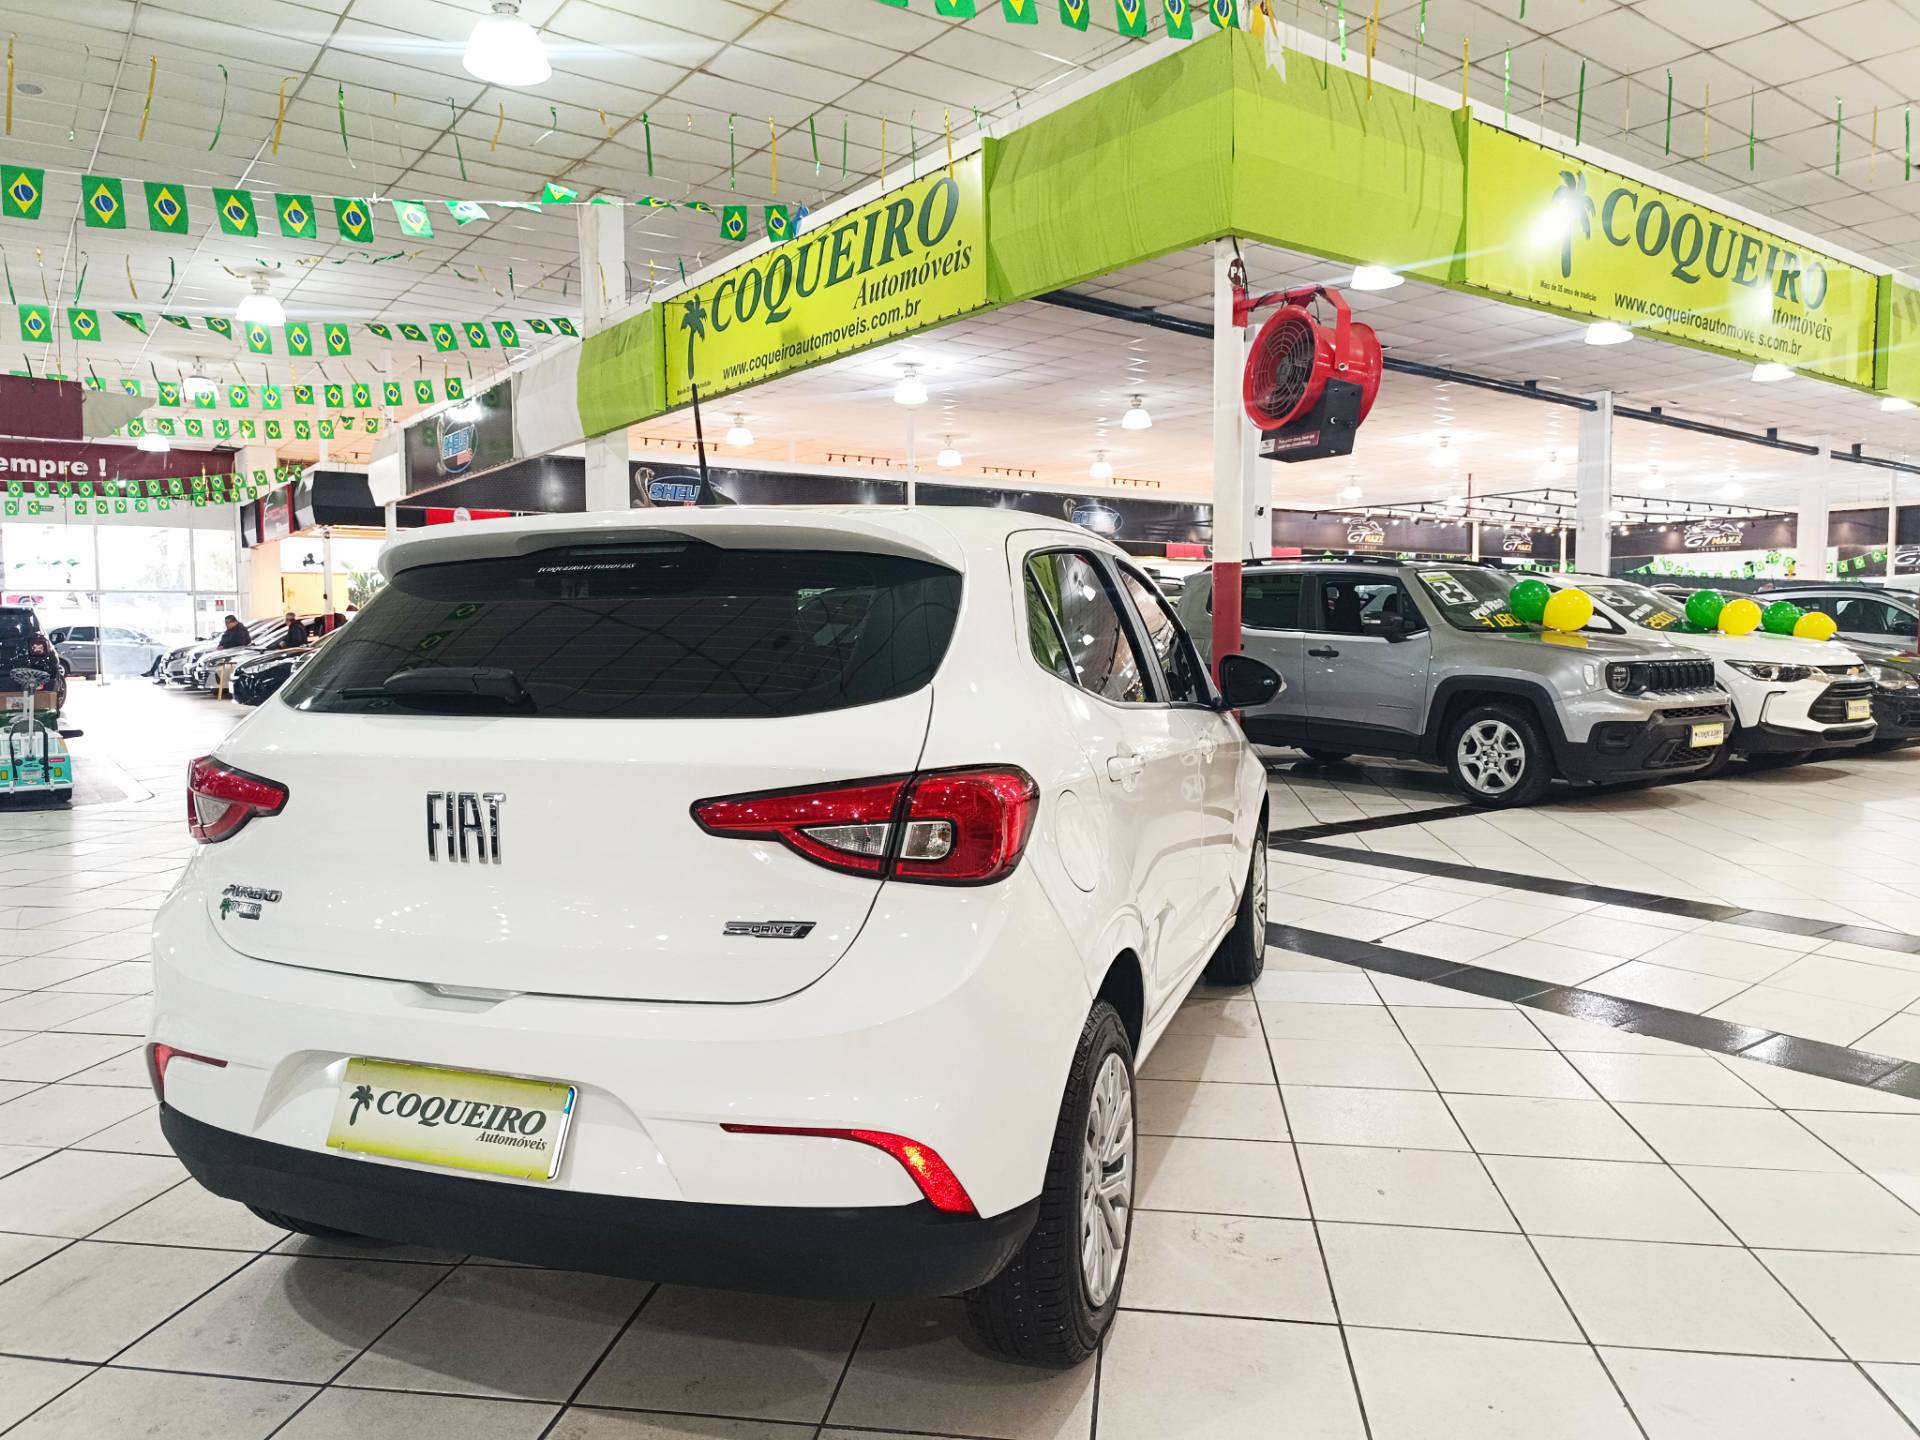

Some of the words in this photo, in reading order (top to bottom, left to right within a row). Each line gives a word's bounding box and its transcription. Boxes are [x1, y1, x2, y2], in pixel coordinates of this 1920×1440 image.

[711, 177, 960, 333] COQUEIRO
[853, 240, 972, 310] Automóveis
[1602, 188, 1828, 310] COQUEIRO
[723, 299, 921, 380] www.coqueiroautomoveis.com.br
[1614, 293, 1803, 356] www.coqueiroautomoves.com.br
[99, 458, 106, 476] !
[649, 482, 700, 501] SHEL
[426, 791, 507, 865] FIAT
[377, 1090, 547, 1136] COQUEIRO
[476, 1131, 547, 1151] Automóveis
